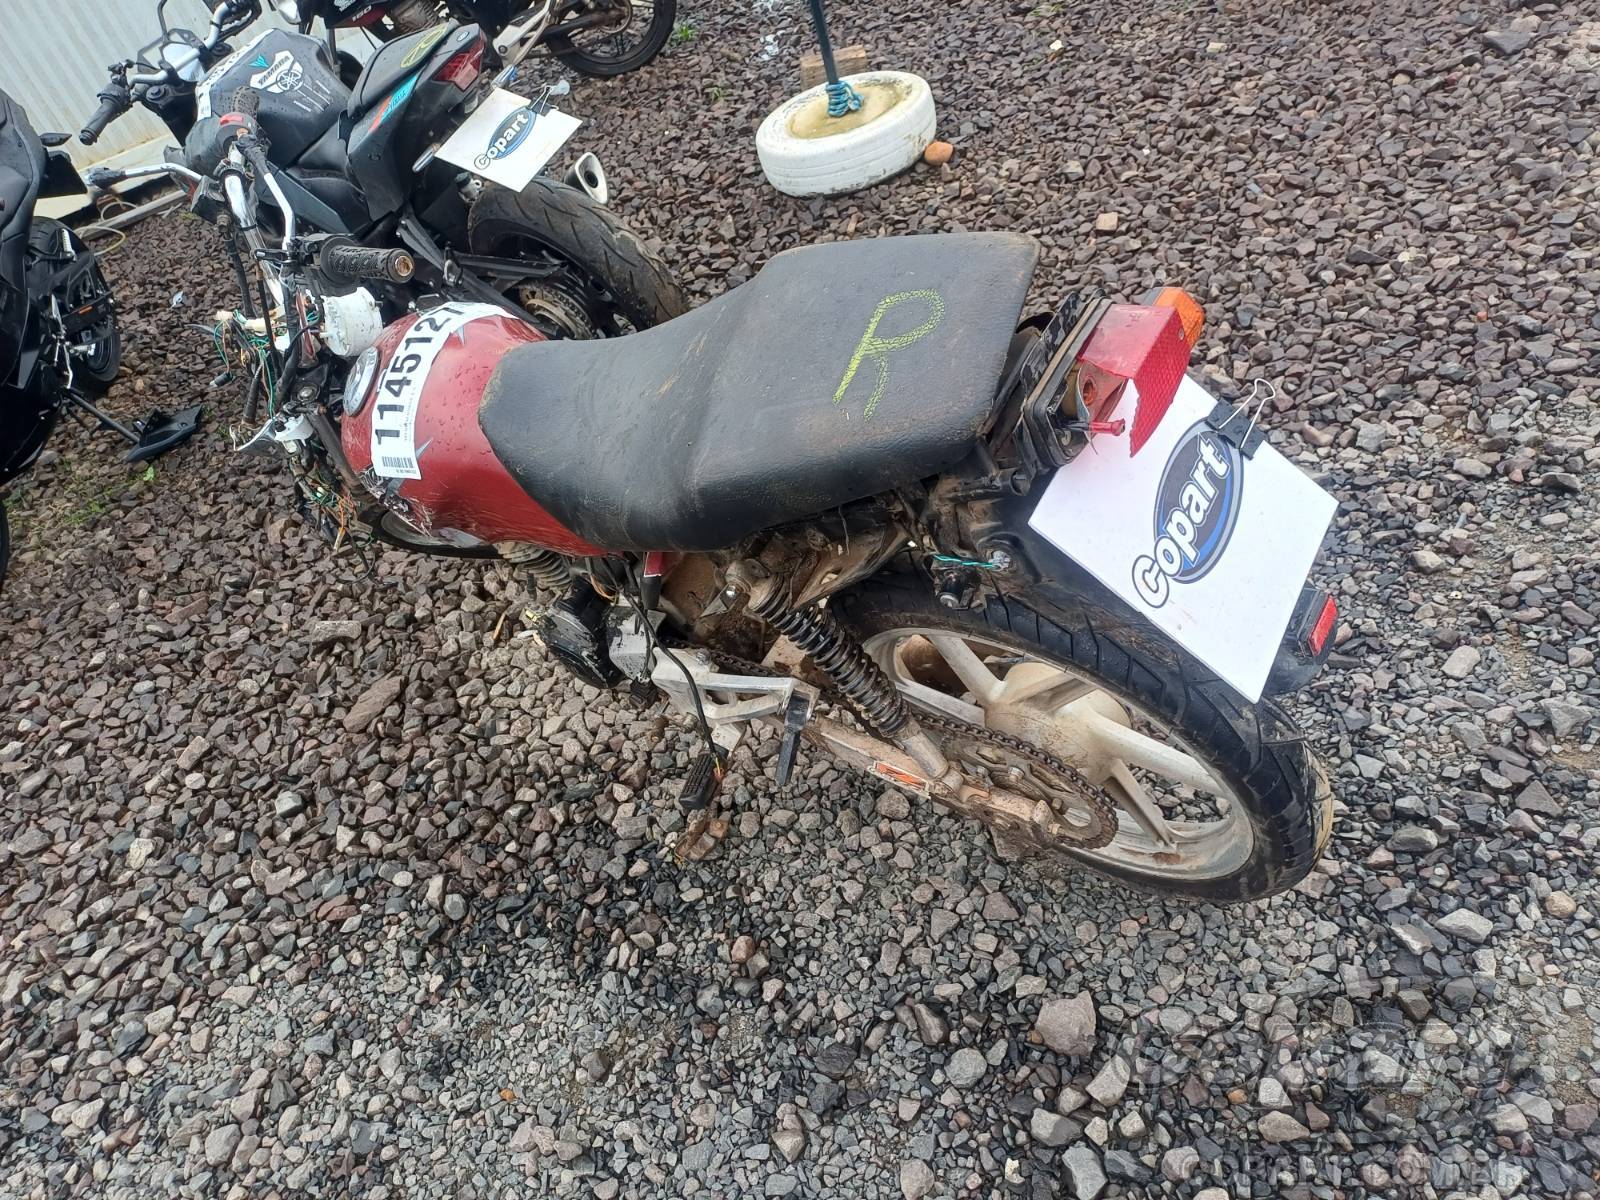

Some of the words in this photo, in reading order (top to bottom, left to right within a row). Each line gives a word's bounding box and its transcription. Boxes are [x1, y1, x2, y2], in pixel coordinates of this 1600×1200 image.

[473, 113, 529, 171] Copart
[832, 288, 945, 421] R
[1131, 431, 1231, 609] Copart
